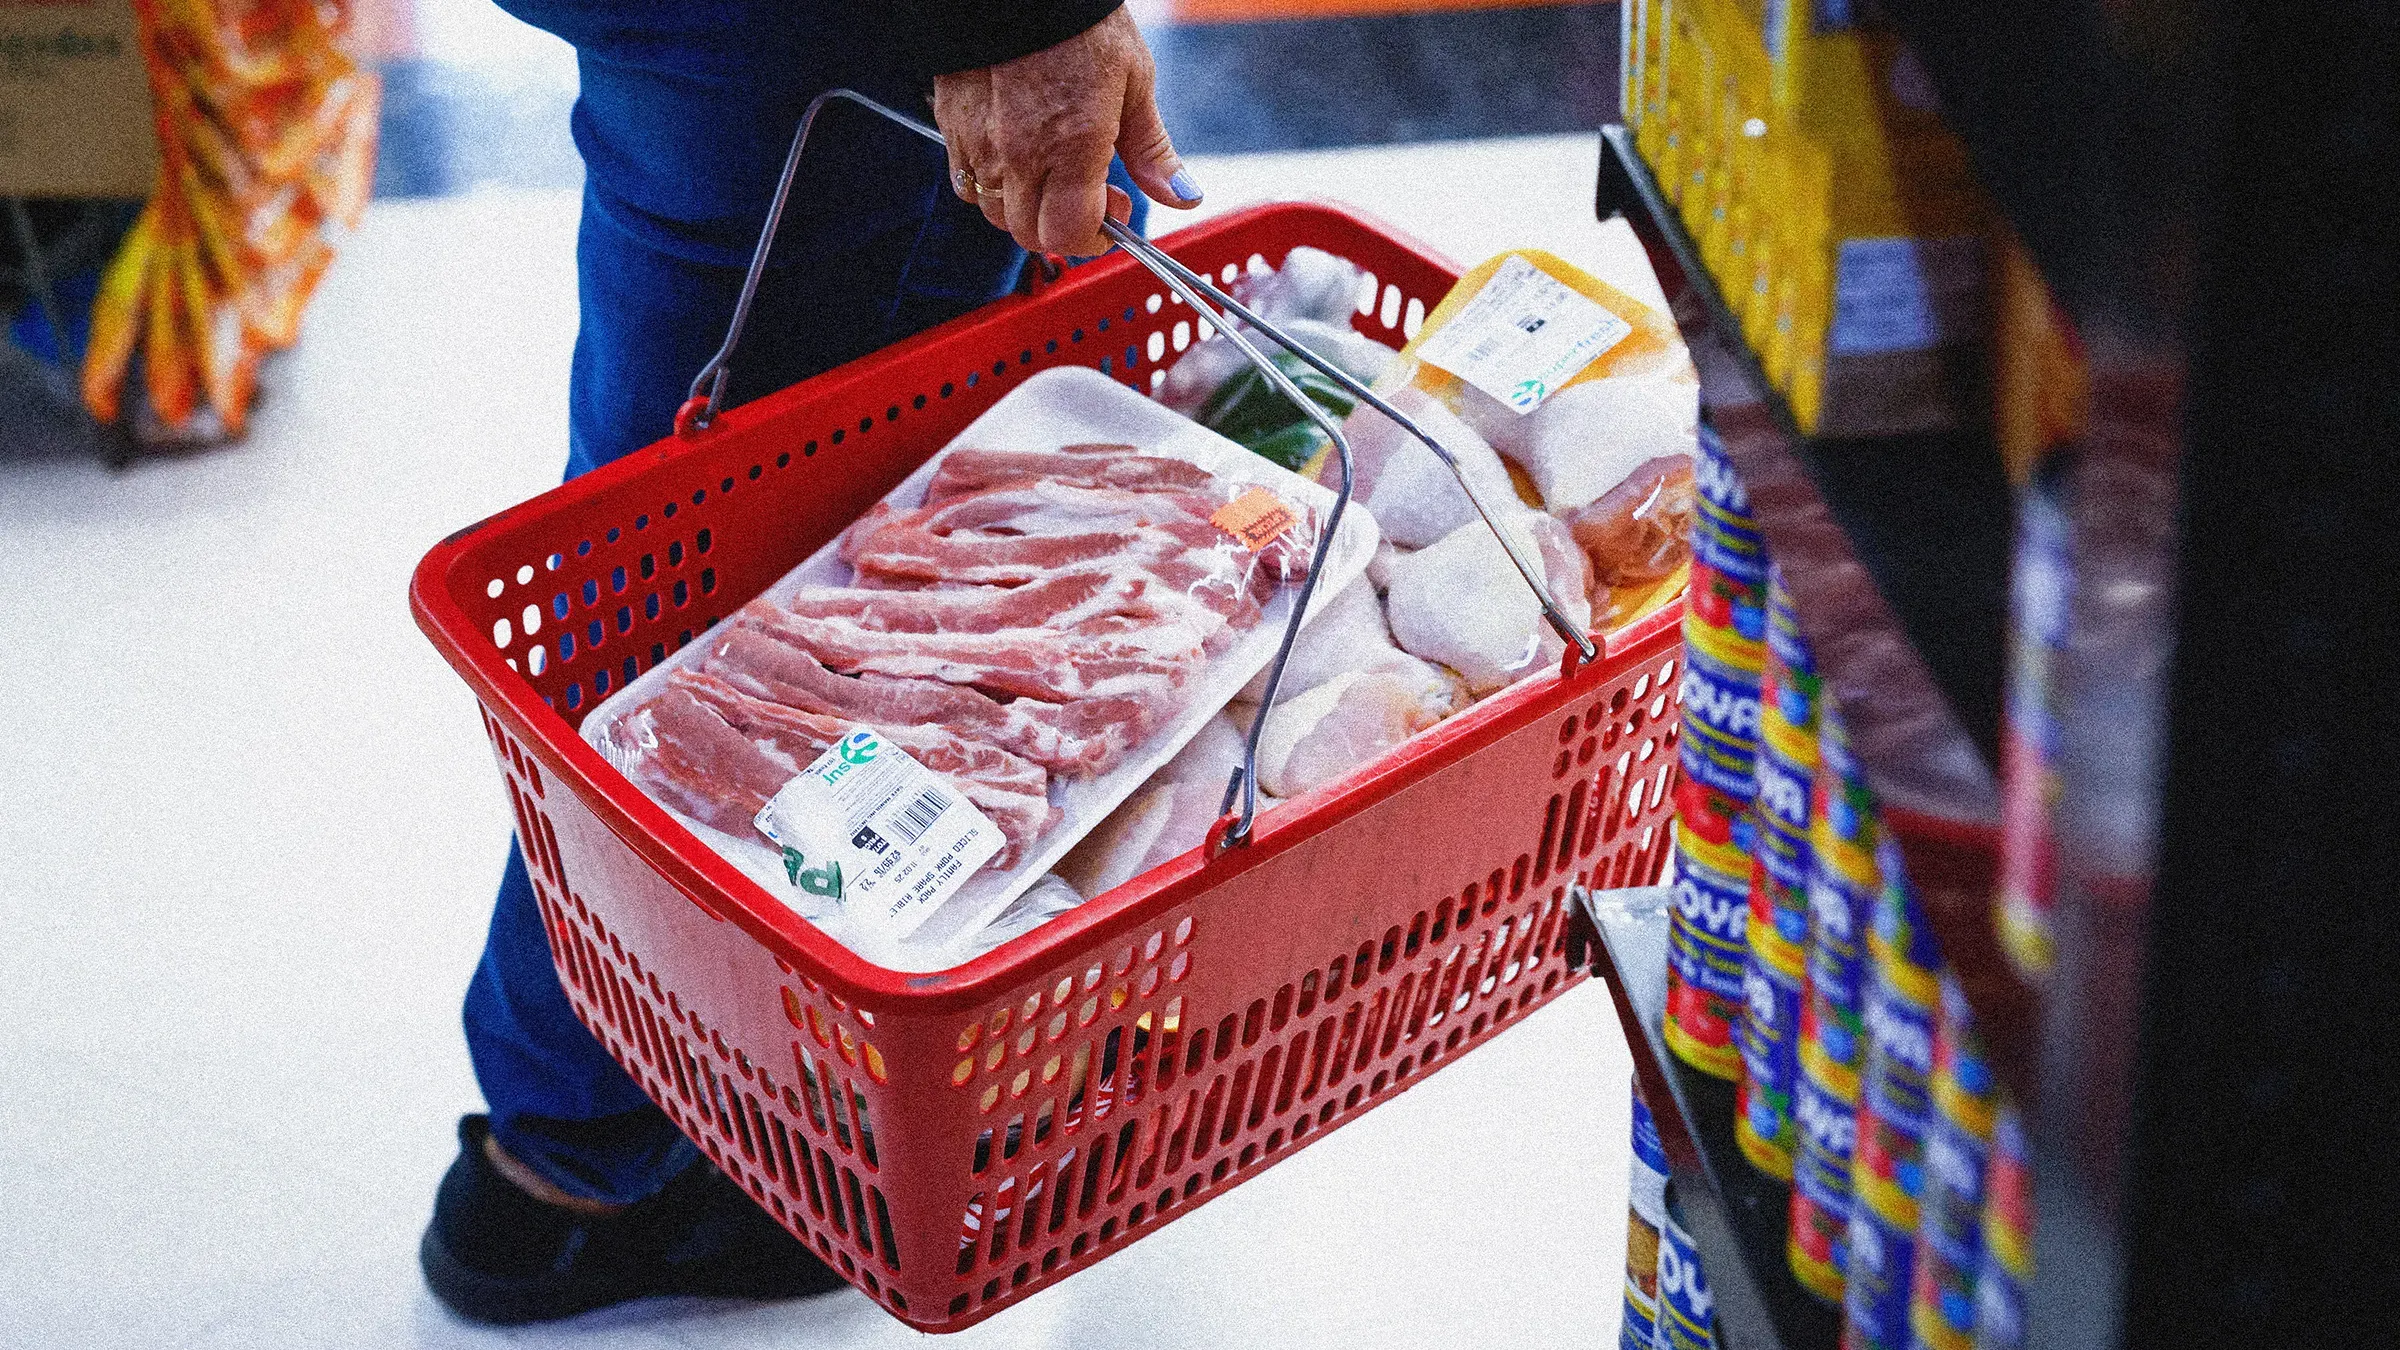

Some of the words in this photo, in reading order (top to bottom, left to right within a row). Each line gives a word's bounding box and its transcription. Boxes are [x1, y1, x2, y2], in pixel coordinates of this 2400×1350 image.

[864, 833, 881, 850] PRIC
[872, 838, 886, 853] TOT
[952, 828, 979, 853] SLICED
[934, 852, 954, 872] PORK
[937, 859, 963, 886] FAMILY
[912, 871, 935, 893] SPARE
[889, 892, 913, 918] RIBLE
[916, 885, 937, 904] PACK
